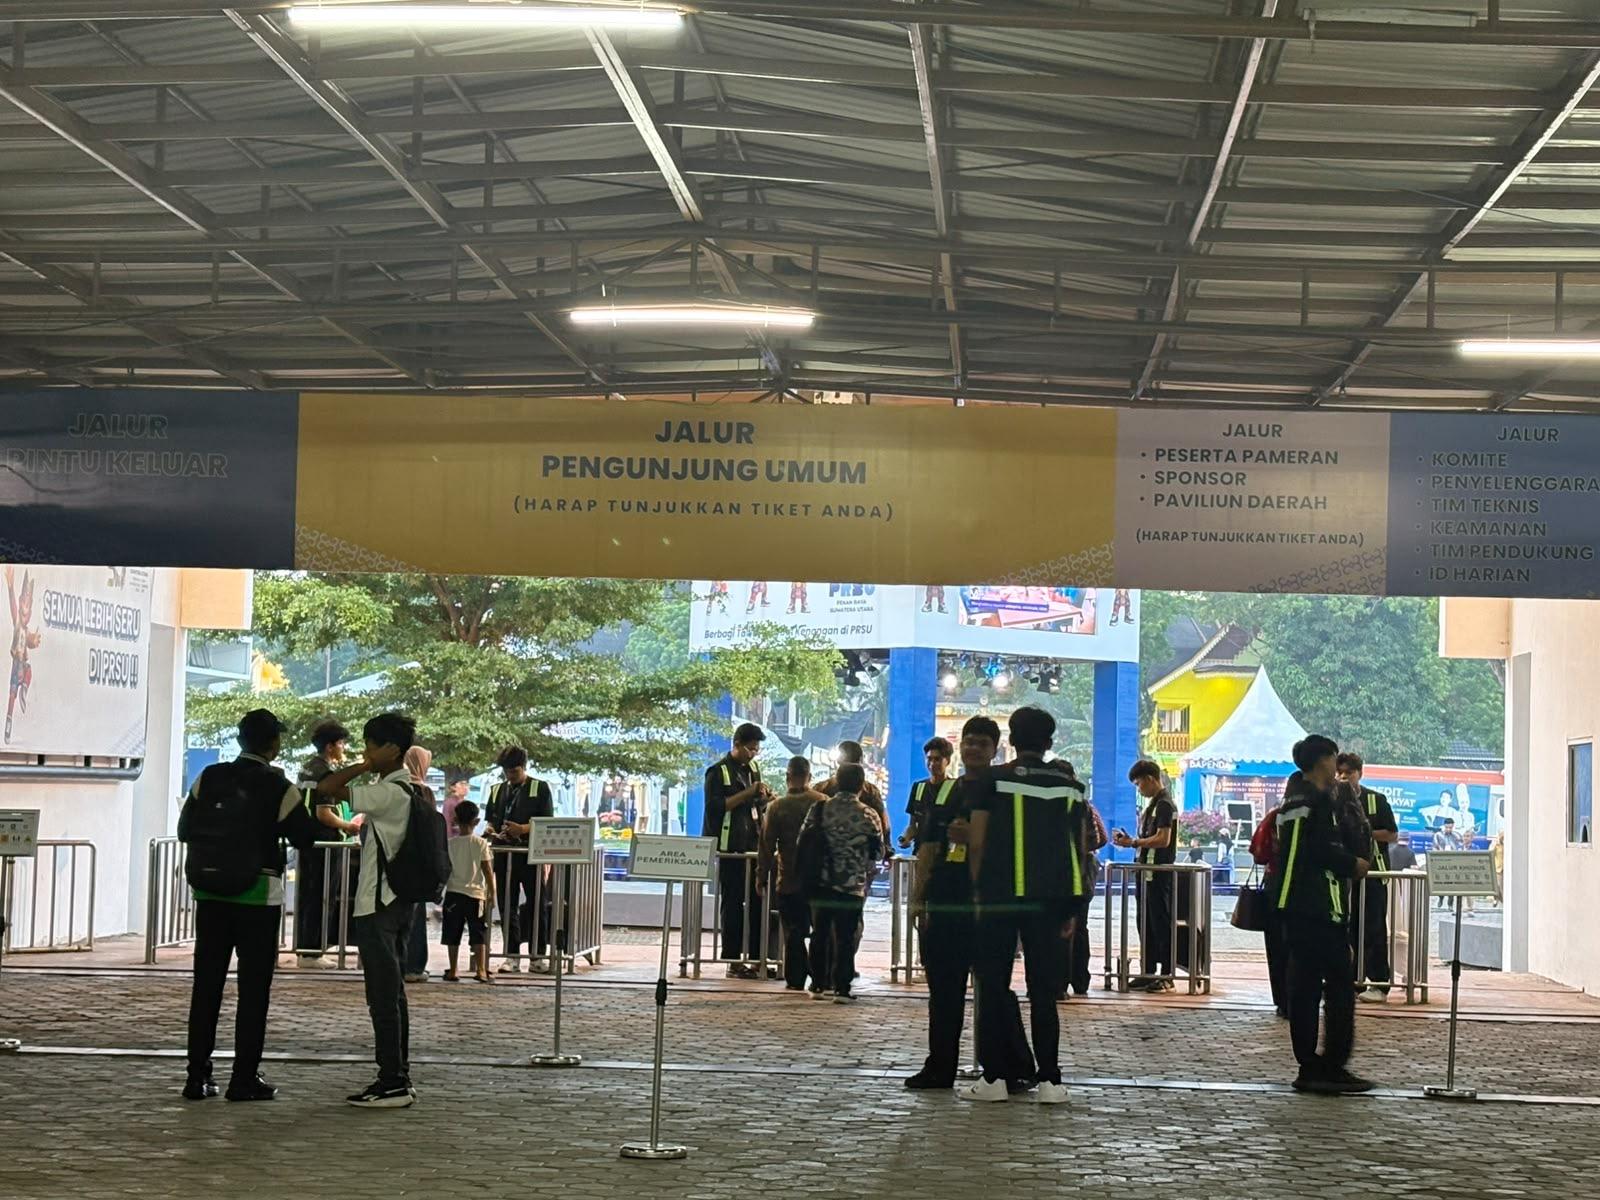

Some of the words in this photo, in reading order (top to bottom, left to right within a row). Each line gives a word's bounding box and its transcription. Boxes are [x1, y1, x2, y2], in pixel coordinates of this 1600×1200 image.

[69, 413, 168, 439] JALUR
[655, 420, 755, 444] JALUR
[1223, 424, 1284, 438] JALUR
[1498, 427, 1560, 442] JALUR
[6, 448, 100, 473] PINTU
[105, 450, 228, 478] KELUAR
[1155, 448, 1237, 462] PESERTA
[1242, 450, 1339, 465] PAMERAN
[1432, 452, 1508, 467] KOMITE
[542, 455, 758, 481] PENGUNJUNG
[765, 459, 867, 484] UMUM
[1154, 471, 1247, 486] SPONSOR
[1432, 475, 1600, 492] PENYELENGGARA
[514, 495, 598, 513] (HARAP
[608, 500, 742, 515] TUNJUKKAN
[751, 502, 811, 516] TIKET
[822, 503, 893, 521] ANDA)
[1153, 493, 1243, 508] PAVILIUN
[1247, 495, 1328, 510] DAERAH
[1432, 498, 1465, 512] TIM
[1471, 499, 1540, 514] TEKNIS
[1430, 521, 1547, 536] KEAMANAN
[1136, 528, 1189, 544] (HARAP
[1192, 531, 1276, 545] TUNJUKKAN
[1279, 533, 1316, 545] TIKET
[1318, 533, 1364, 547] ANDA)
[1431, 544, 1464, 558] TIM
[1470, 545, 1593, 560] PENDUKUNG
[1430, 567, 1448, 581] ID
[1454, 567, 1530, 582] HARIAN
[43, 589, 84, 633] SEMUA
[84, 598, 115, 640] LEBIH
[113, 604, 141, 642] SERU
[850, 624, 873, 635] PRSU
[89, 648, 101, 684] DI
[101, 650, 130, 688] PRSU
[636, 856, 708, 866] PEMERIKSAAN
[660, 850, 687, 858] AREA
